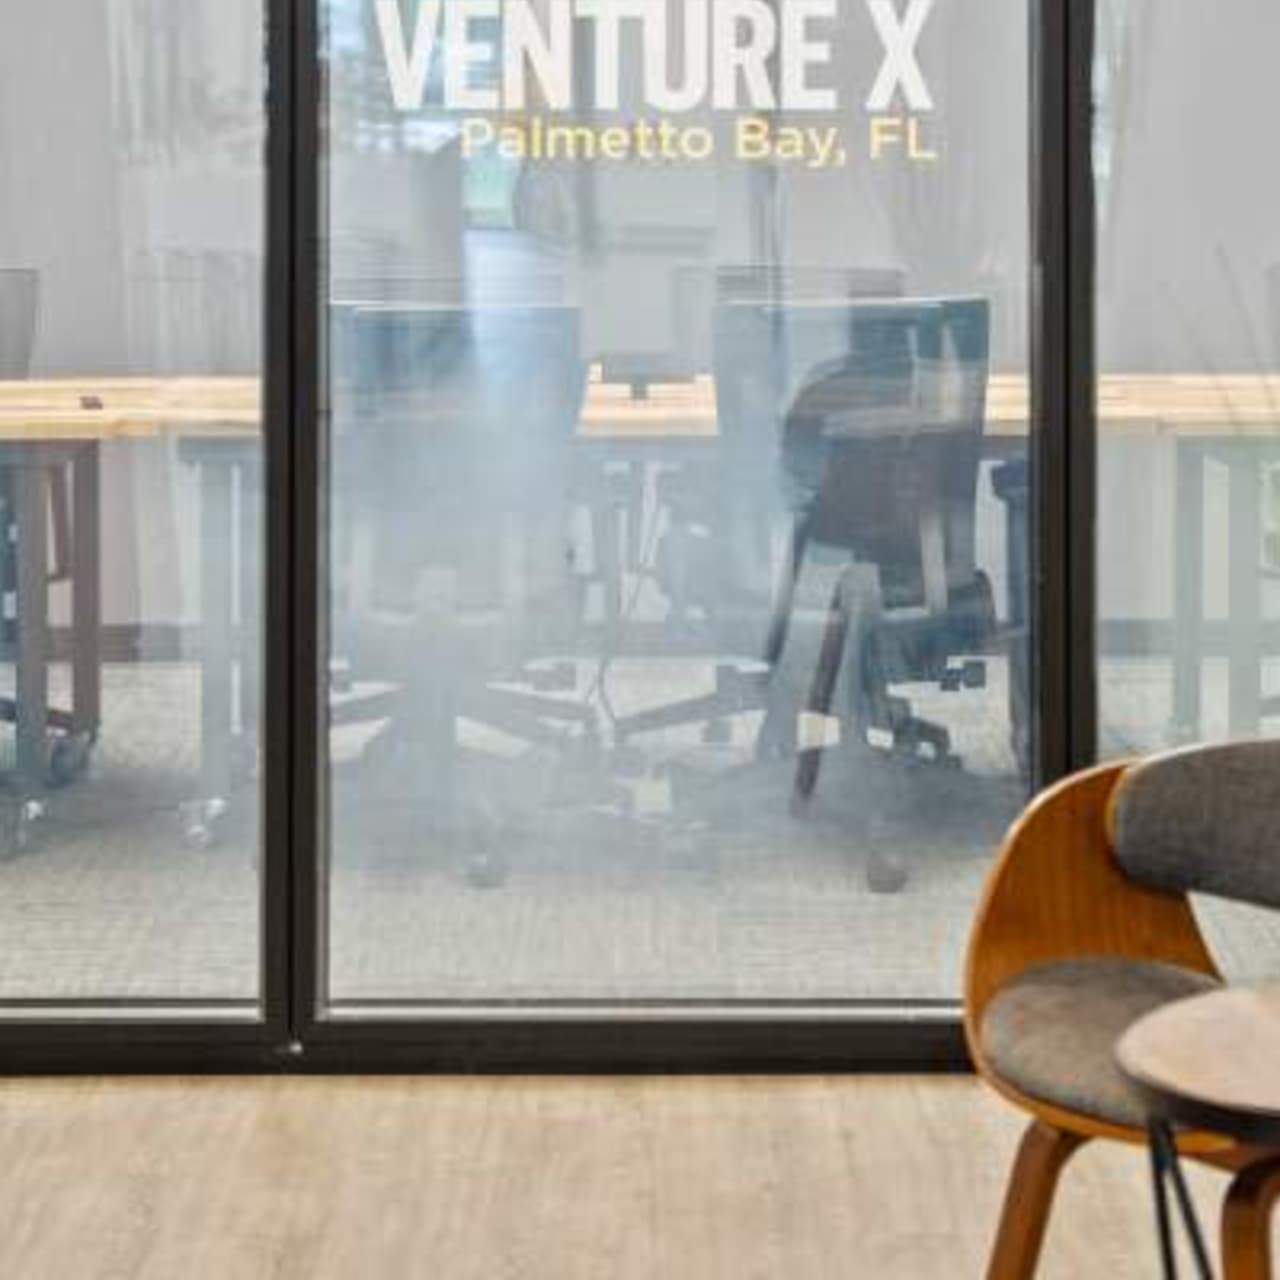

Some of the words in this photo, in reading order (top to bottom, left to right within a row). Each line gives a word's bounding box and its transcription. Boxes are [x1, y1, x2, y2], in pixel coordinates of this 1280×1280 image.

[460, 117, 715, 160] Palmetto
[735, 117, 847, 167] Bay,
[870, 118, 938, 160] FL
